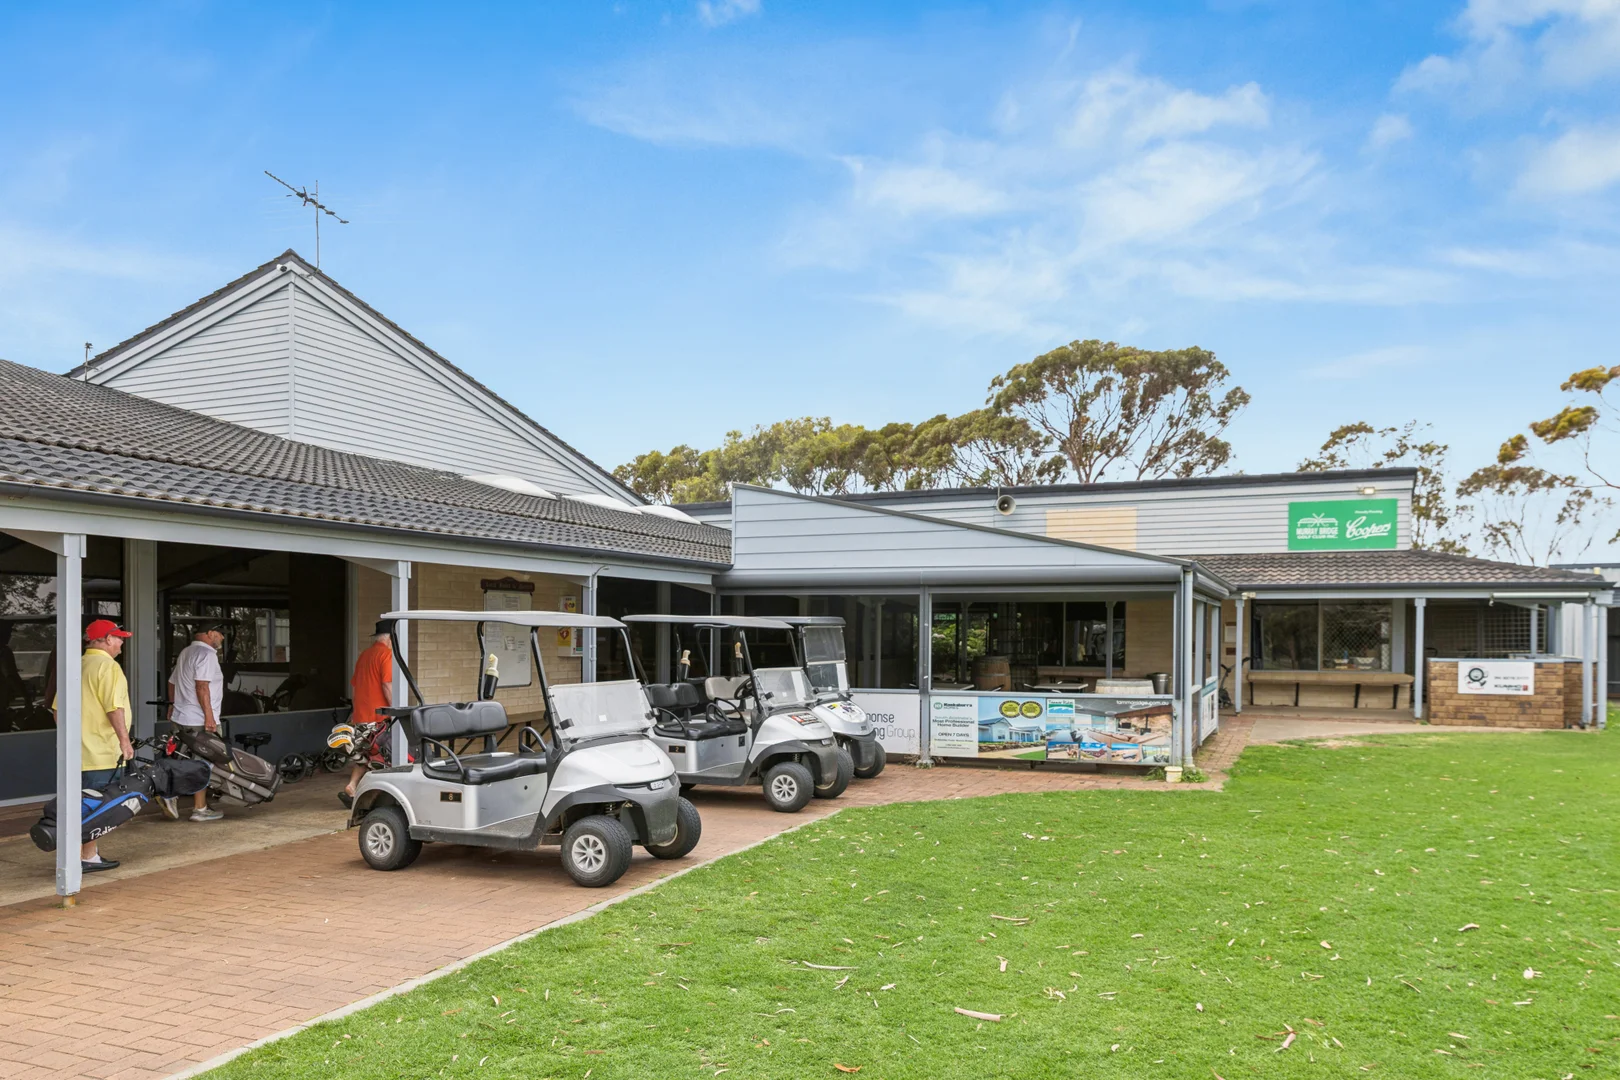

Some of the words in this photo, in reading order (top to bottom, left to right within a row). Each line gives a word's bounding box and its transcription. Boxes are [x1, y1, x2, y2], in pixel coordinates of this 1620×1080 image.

[1346, 516, 1392, 539] Coopers
[872, 724, 885, 740] ng
[887, 725, 915, 740] Group
[449, 792, 453, 800] 8
